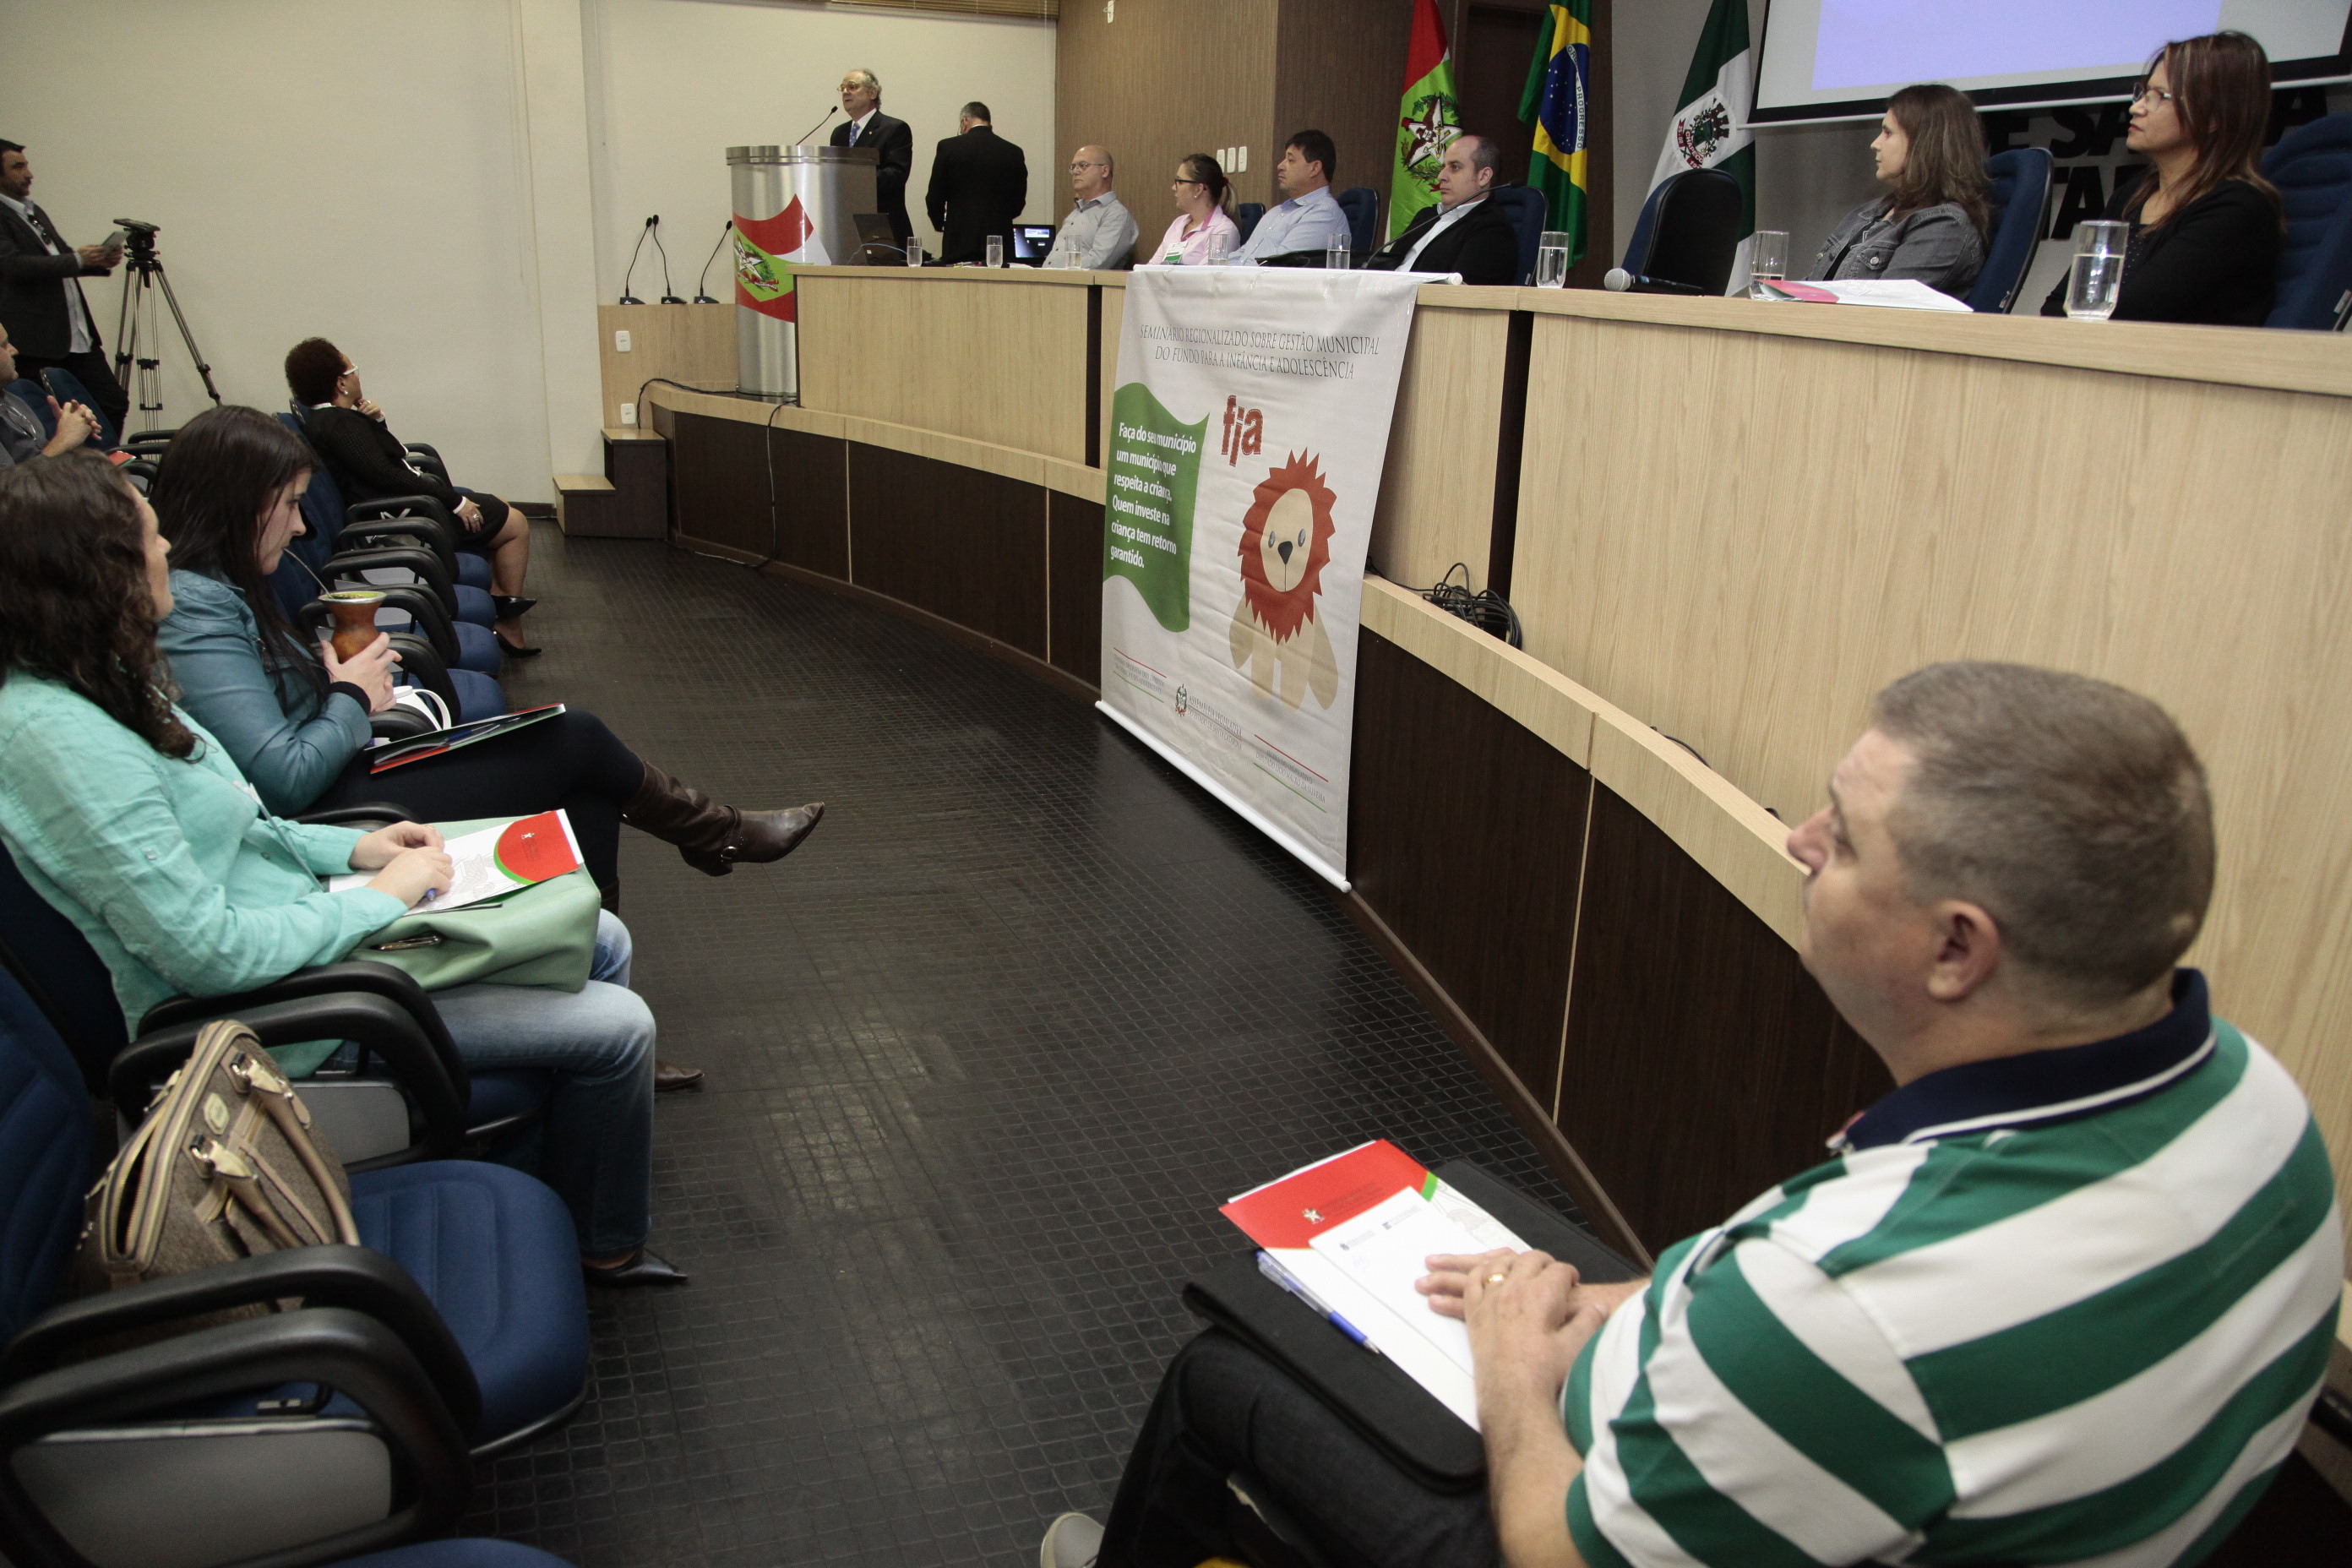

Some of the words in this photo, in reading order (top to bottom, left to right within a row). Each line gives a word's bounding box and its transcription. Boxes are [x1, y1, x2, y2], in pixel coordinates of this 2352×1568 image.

[1576, 86, 1585, 149] PROGRESSO
[1141, 324, 1184, 341] SEMINÁRIO
[1185, 328, 1249, 346] REGIONALIZADO
[1250, 331, 1277, 349] SOBRE
[1279, 331, 1314, 351] GESTÃO
[1316, 335, 1380, 355] MUNICIPAL
[1155, 346, 1171, 361] DO
[1173, 347, 1200, 363] FUNDO
[1200, 351, 1218, 366] PARA
[1219, 352, 1224, 368] A
[1227, 351, 1267, 372] INFÂNCIA
[1270, 357, 1275, 373] E
[1277, 357, 1354, 379] ADOLESCÊNCIA
[1119, 422, 1135, 443] Faça
[1136, 425, 1146, 442] do
[1146, 431, 1157, 445] seu
[1157, 433, 1196, 455] município
[1116, 449, 1129, 463] um
[1129, 452, 1162, 473] município
[1162, 460, 1177, 477] que
[1113, 473, 1142, 491] respeita
[1143, 482, 1148, 493] a
[1113, 494, 1134, 514] Quem
[1135, 500, 1161, 523] investe
[1161, 512, 1170, 525] na
[1111, 520, 1135, 542] criança
[1136, 527, 1151, 545] tem
[1152, 535, 1177, 554] retorno
[1110, 545, 1145, 569] garantido.
